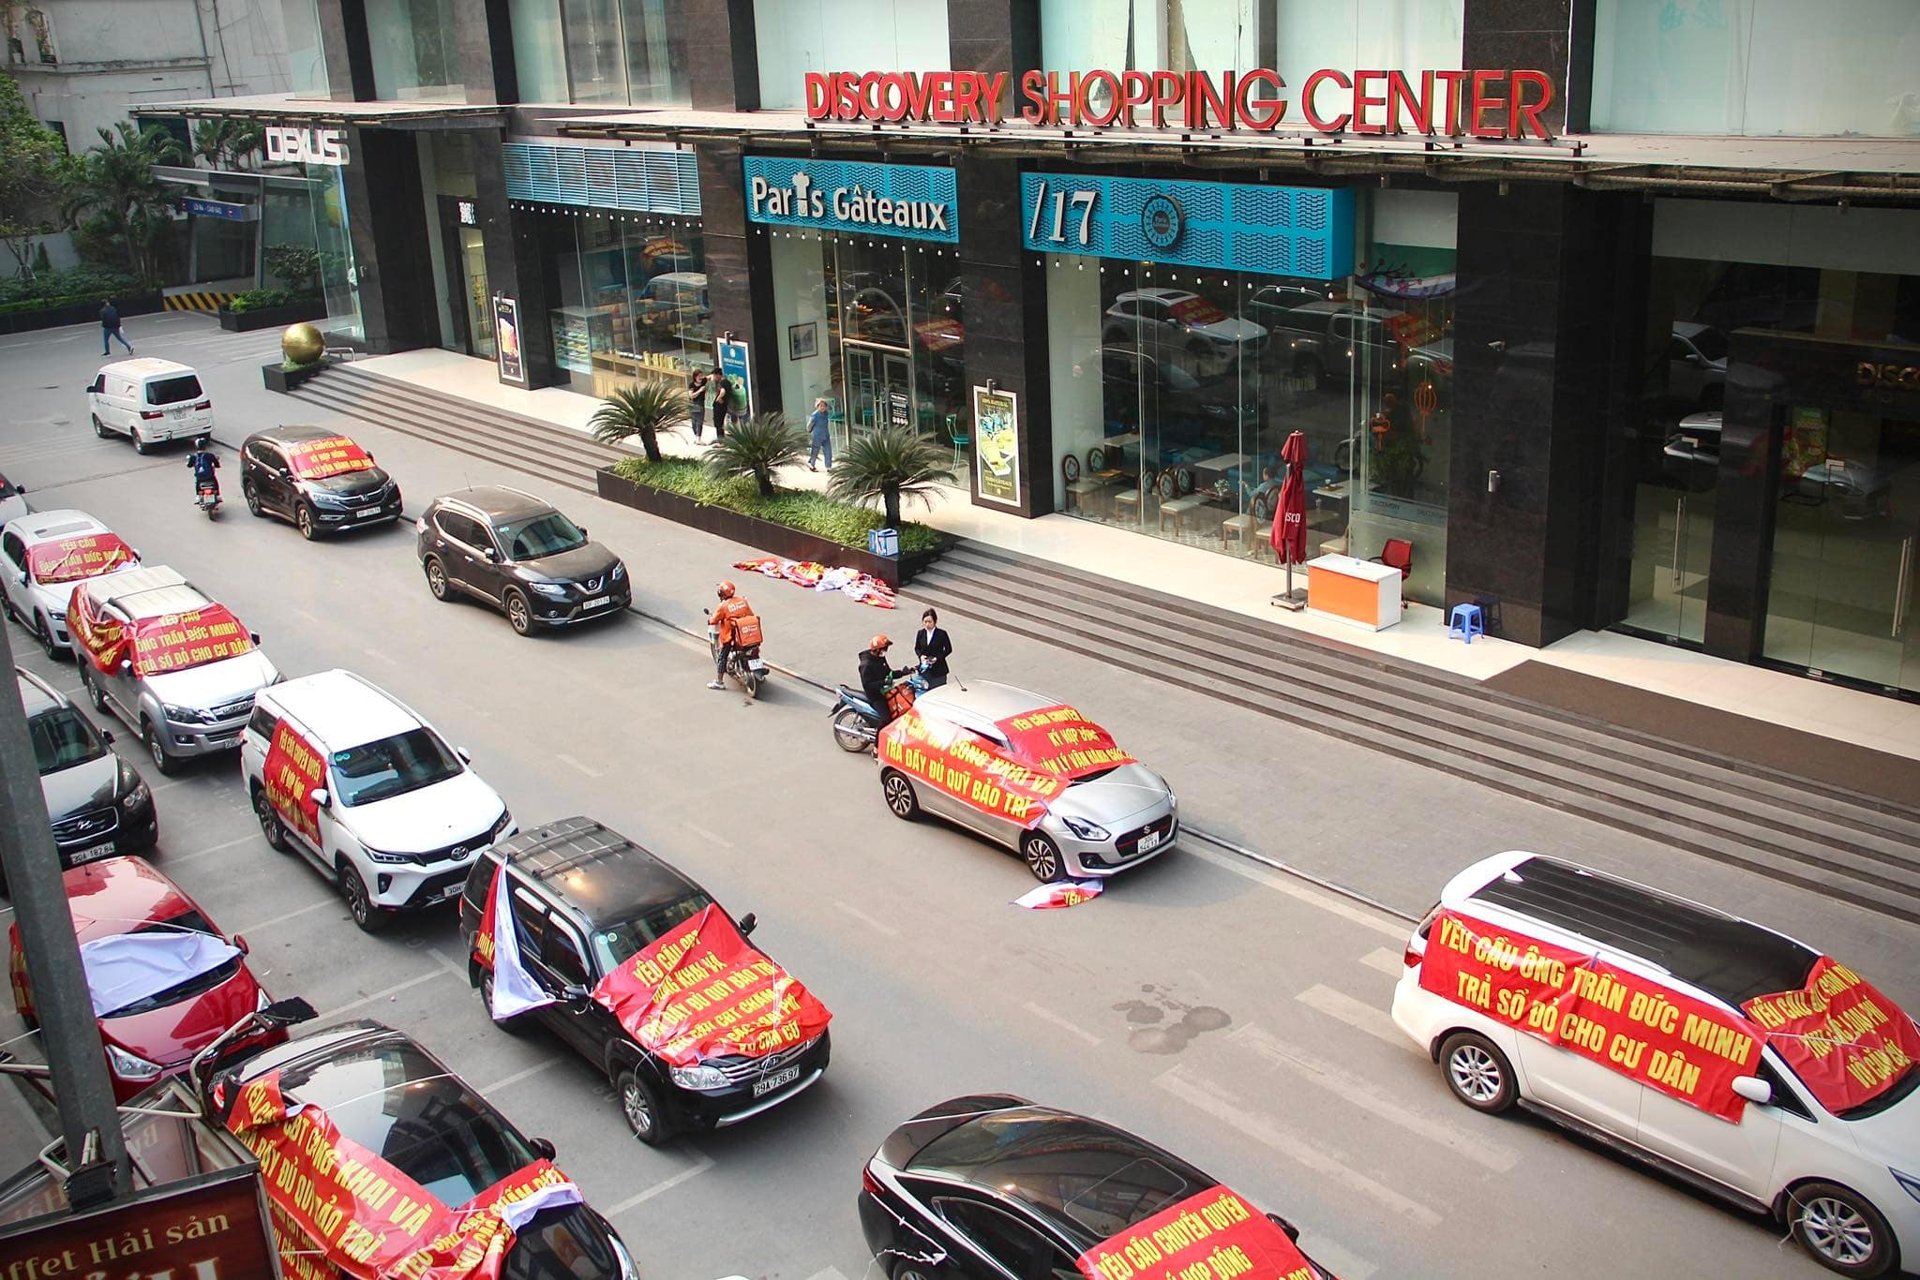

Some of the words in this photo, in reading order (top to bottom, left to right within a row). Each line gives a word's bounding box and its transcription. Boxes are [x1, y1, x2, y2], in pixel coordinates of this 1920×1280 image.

[804, 71, 1009, 124] DISCOVERY
[1022, 68, 1288, 131] SHOPPING
[1302, 69, 1556, 140] CENTER
[265, 126, 349, 165] DEXUS
[832, 184, 948, 231] Gâteaux
[208, 622, 239, 637] MINH
[971, 778, 1001, 808] BẢO
[632, 959, 664, 988] YÊU
[656, 943, 684, 972] CẦU
[1439, 917, 1473, 955] YÊU
[1474, 934, 1520, 972] CẦU
[1519, 943, 1568, 990] ÔNG
[1570, 966, 1628, 1014] TRẦN
[1627, 991, 1680, 1034] ĐỨC
[1681, 1012, 1752, 1066] MINH
[1457, 971, 1493, 1010] TRẢ
[1496, 987, 1530, 1021] SỔ
[1528, 997, 1559, 1034] ĐỎ
[1559, 1013, 1608, 1054] CHO
[1608, 1033, 1649, 1069] CƯ
[1646, 1049, 1701, 1096] DÂN
[1749, 996, 1786, 1030] YÊU
[1776, 990, 1813, 1020] CẦU
[276, 1156, 299, 1195] ĐỦ
[335, 1218, 387, 1264] TRÌ
[333, 1158, 398, 1212] KHAI
[389, 1194, 434, 1238] VÀ
[0, 1250, 78, 1280] ffet
[89, 1228, 154, 1264] Hải
[165, 1213, 230, 1245] sản
[1096, 1252, 1134, 1280] YÊU
[1123, 1234, 1163, 1271] CẦU
[1152, 1209, 1213, 1255] CHUYỂN
[1200, 1192, 1251, 1232] QUYỀN
[1207, 1243, 1254, 1280] ĐỒNG
